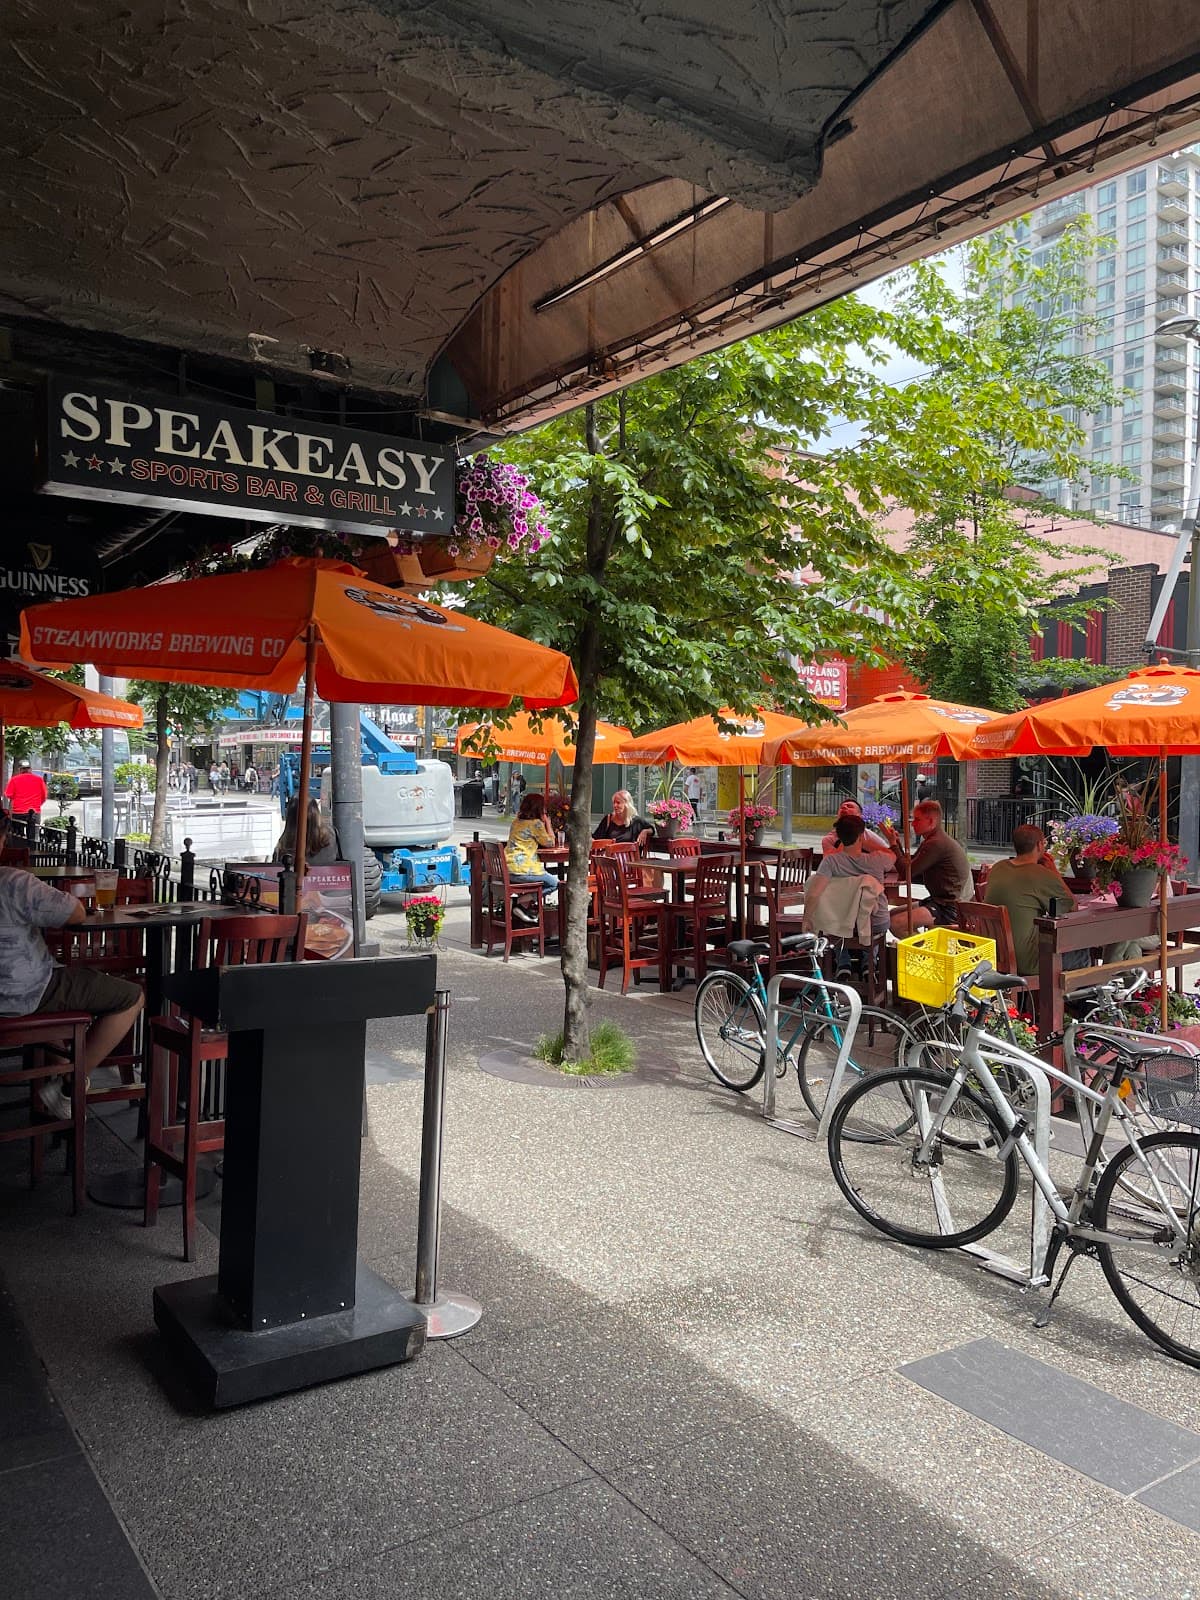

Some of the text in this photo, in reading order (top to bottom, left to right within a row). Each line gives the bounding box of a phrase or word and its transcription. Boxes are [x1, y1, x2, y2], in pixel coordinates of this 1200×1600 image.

[61, 392, 445, 495] SPEAKEASY
[130, 458, 397, 516] SPORTS BAR & GRILL
[33, 626, 163, 651] STEAMWORKS
[169, 633, 254, 656] BREWING
[798, 677, 841, 697] CADE
[793, 744, 934, 759] STEAMWORKS BREWING CO.
